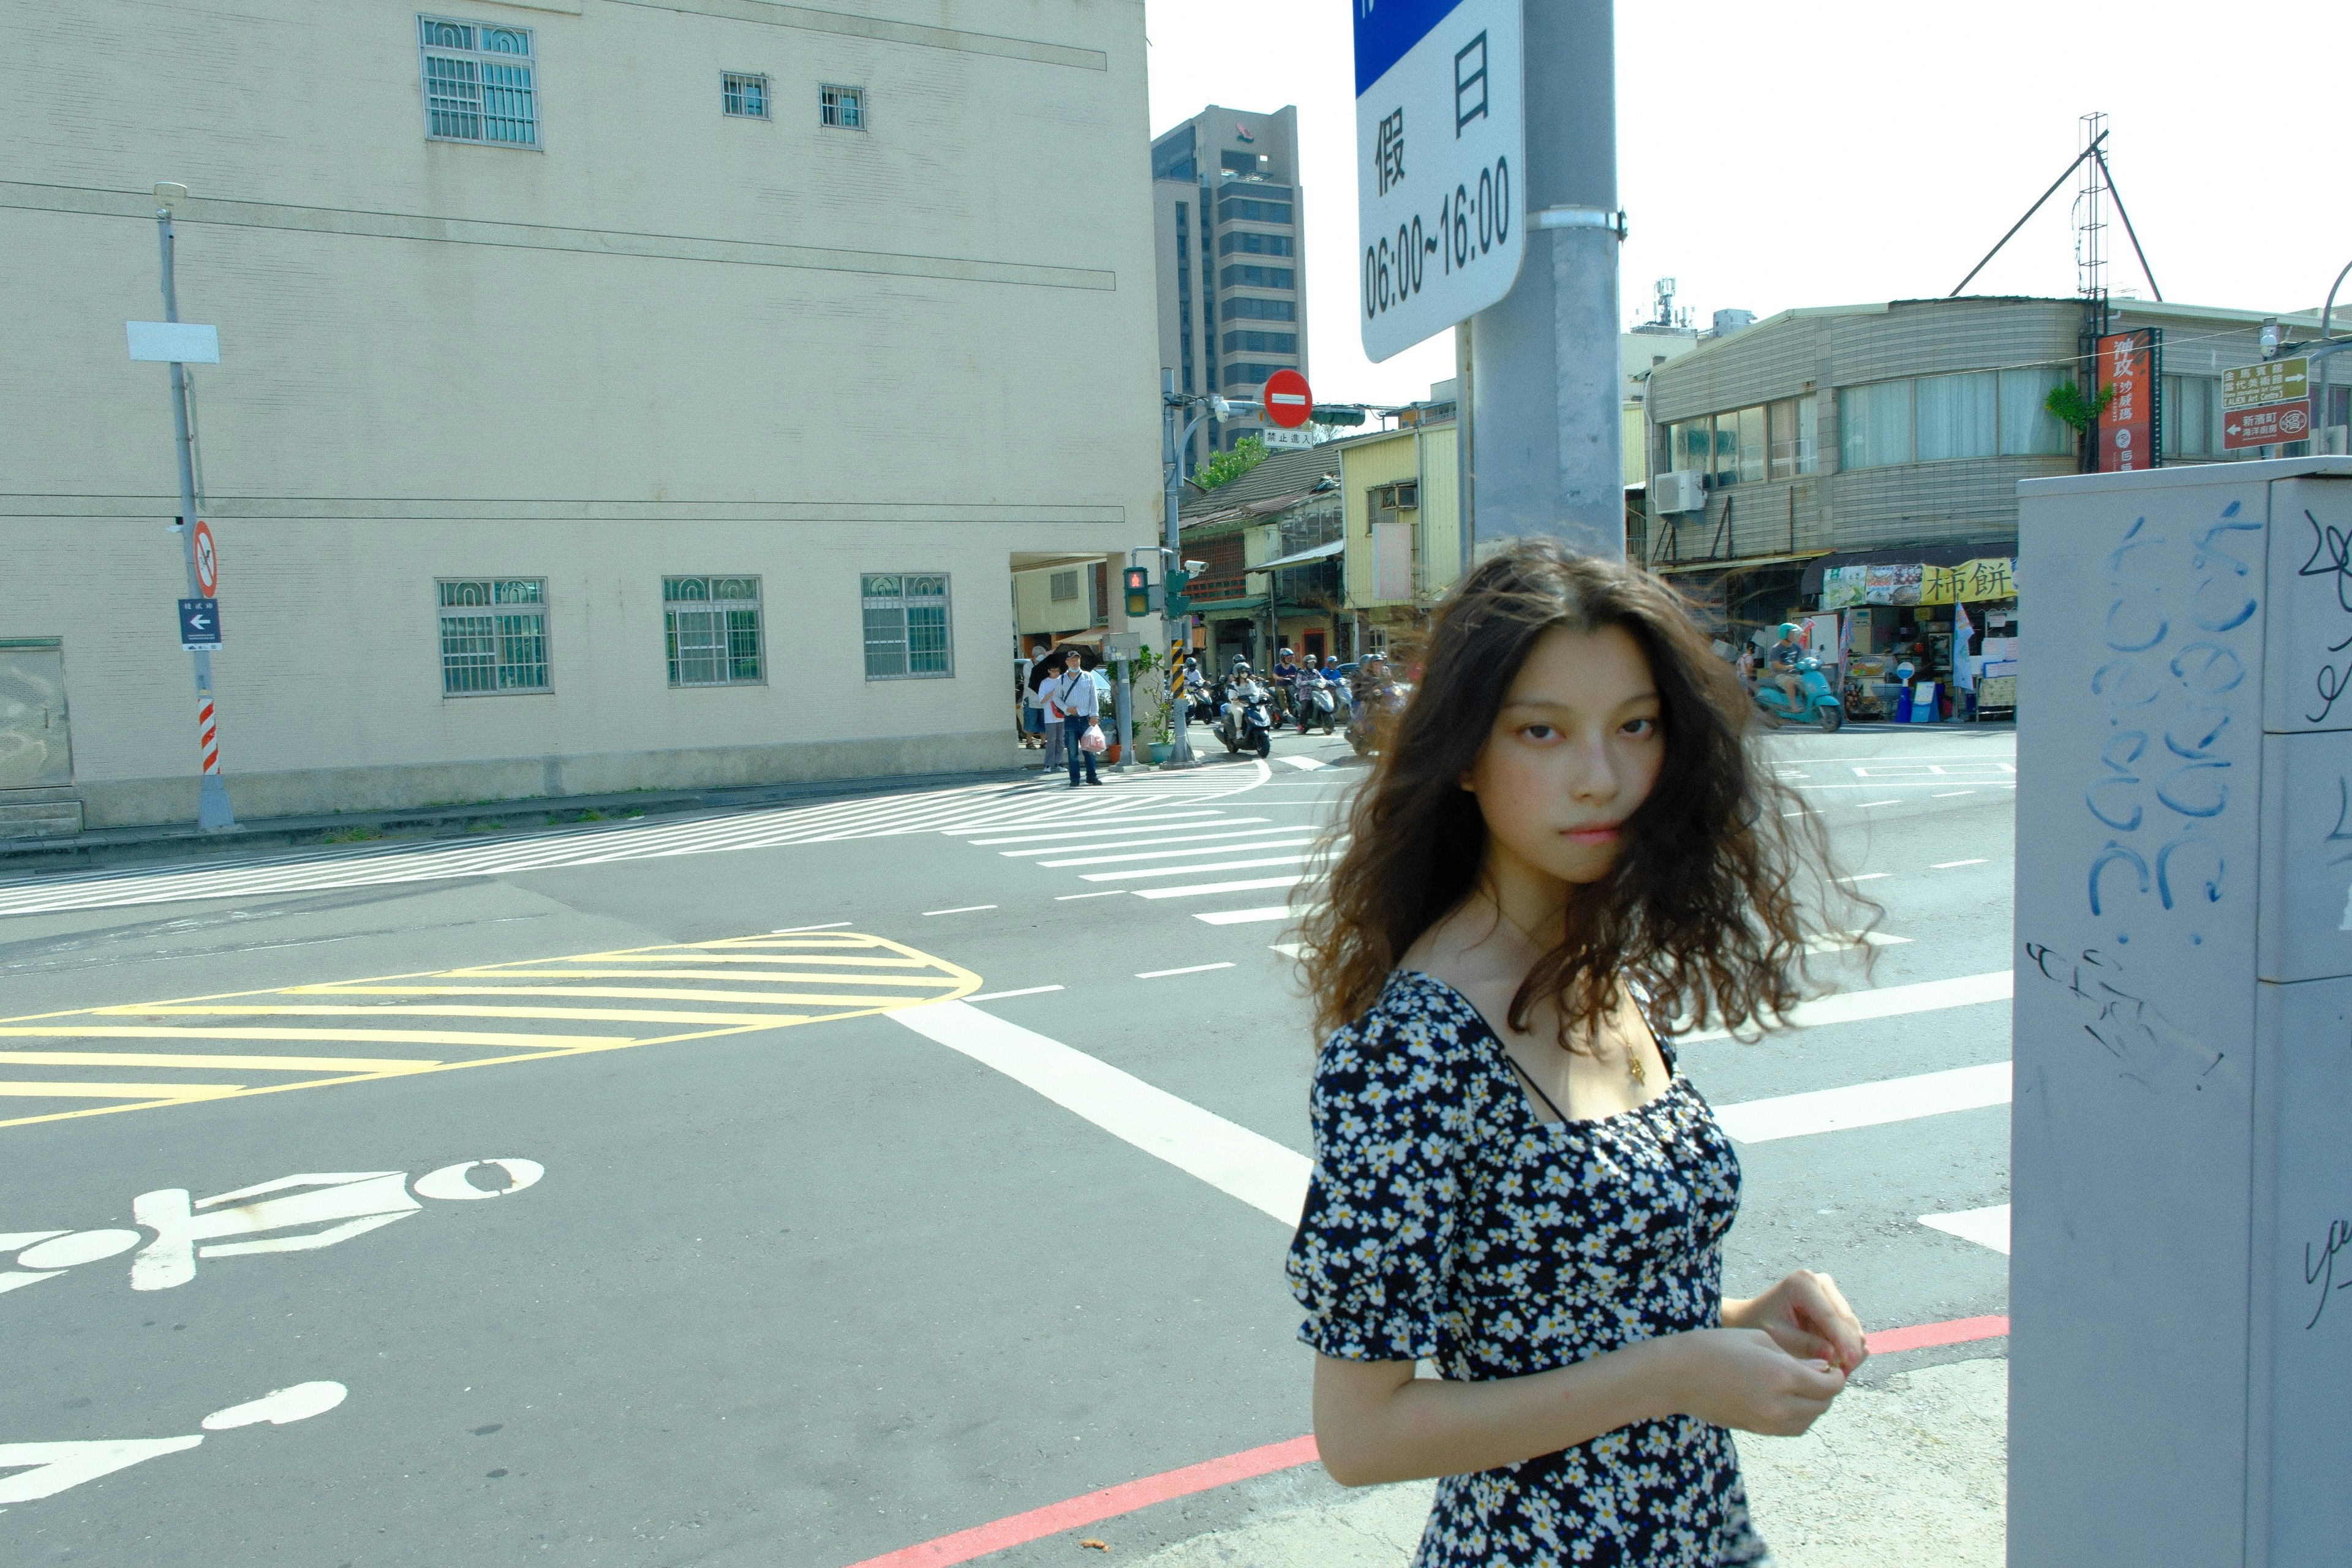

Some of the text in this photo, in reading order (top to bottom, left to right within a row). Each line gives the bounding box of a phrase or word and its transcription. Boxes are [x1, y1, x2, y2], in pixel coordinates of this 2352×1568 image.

[1365, 155, 1509, 320] 06:00~16:00
[2224, 363, 2283, 382] 金馬賓館
[2224, 374, 2283, 392] 當代美術館
[1267, 431, 1310, 445] 禁止進入
[1926, 562, 2011, 603] 柿餅
